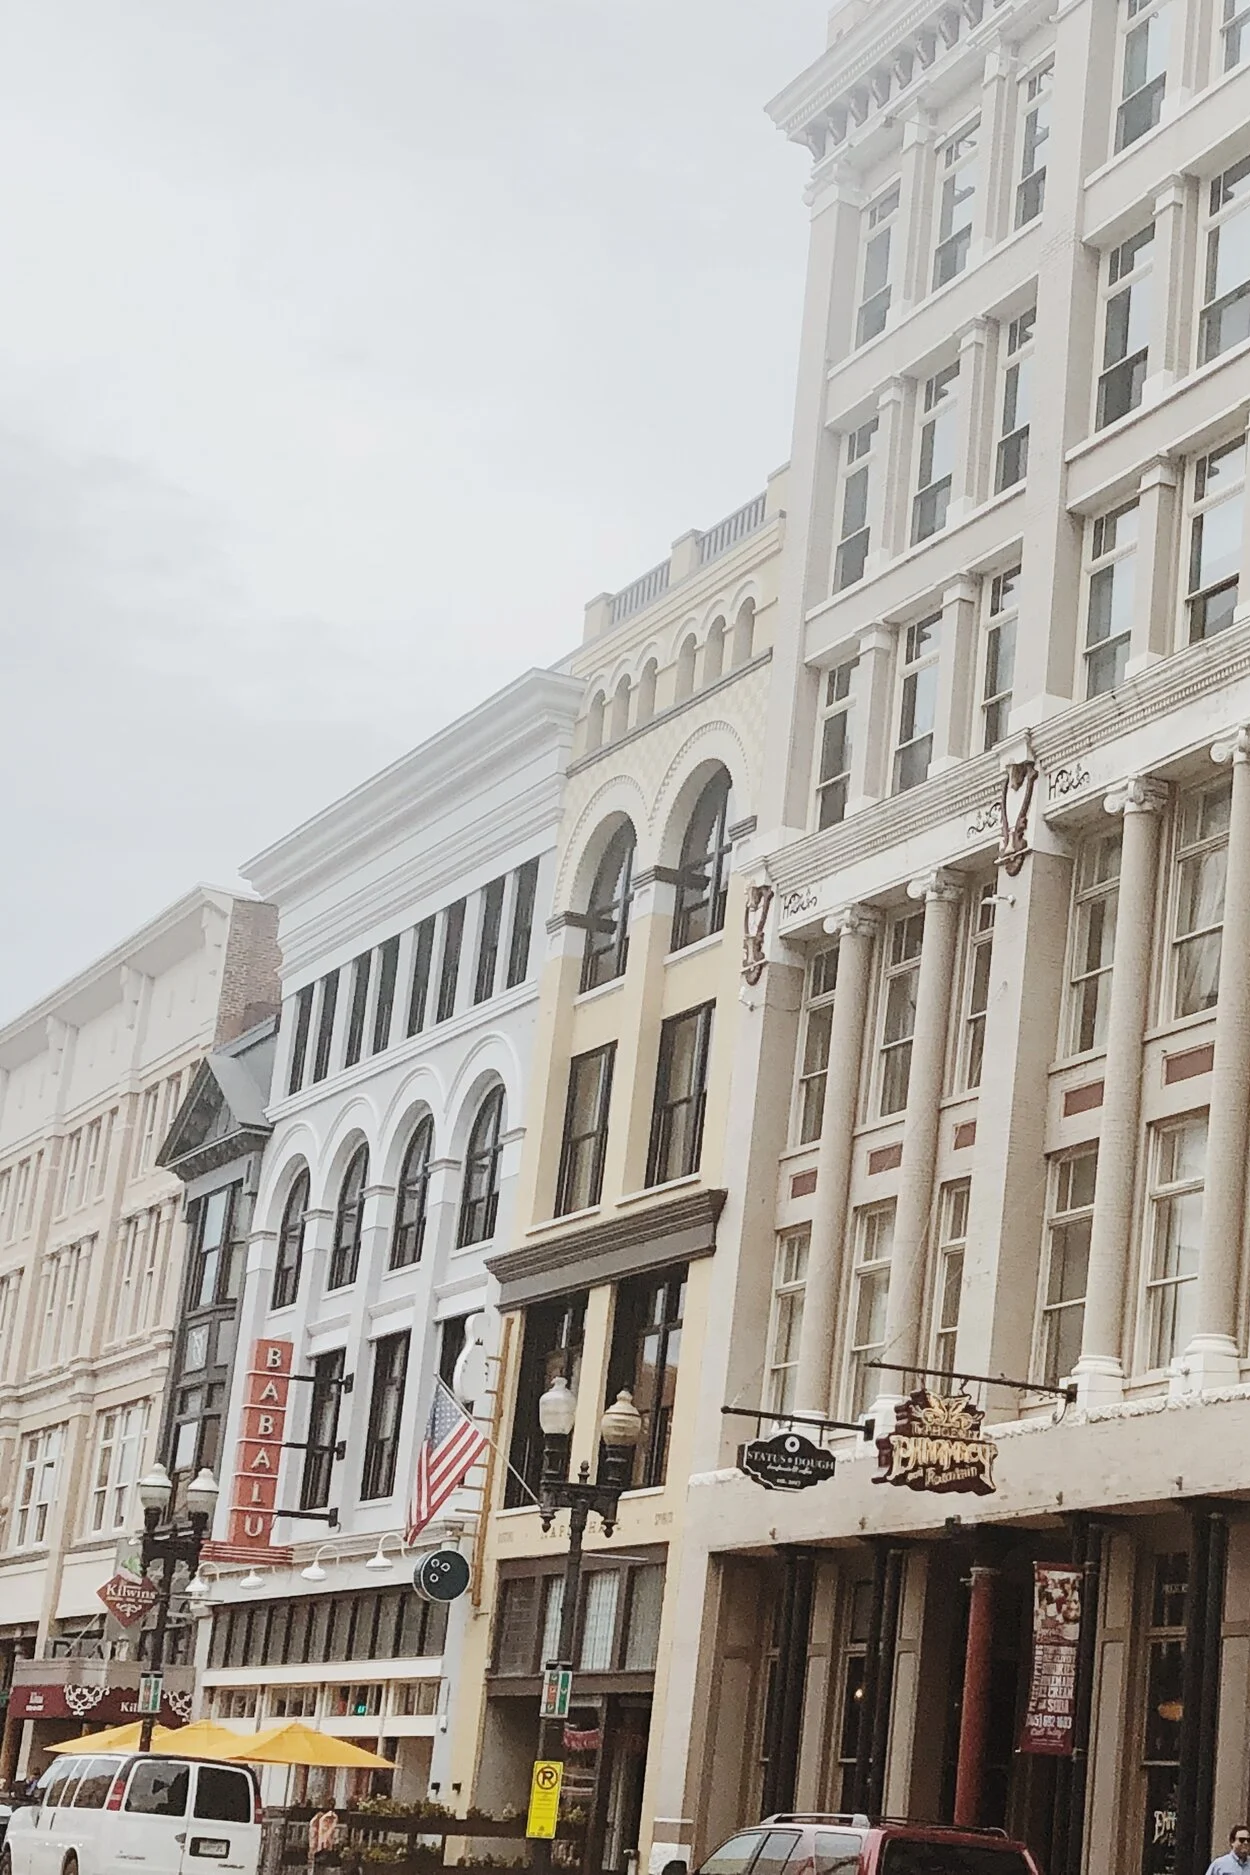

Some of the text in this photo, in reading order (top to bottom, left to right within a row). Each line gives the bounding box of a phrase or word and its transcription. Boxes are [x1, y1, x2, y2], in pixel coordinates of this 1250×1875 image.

[244, 1346, 282, 1538] BABALU
[747, 1451, 834, 1470] STATUS DOUGH
[106, 1582, 158, 1600] Kilwins
